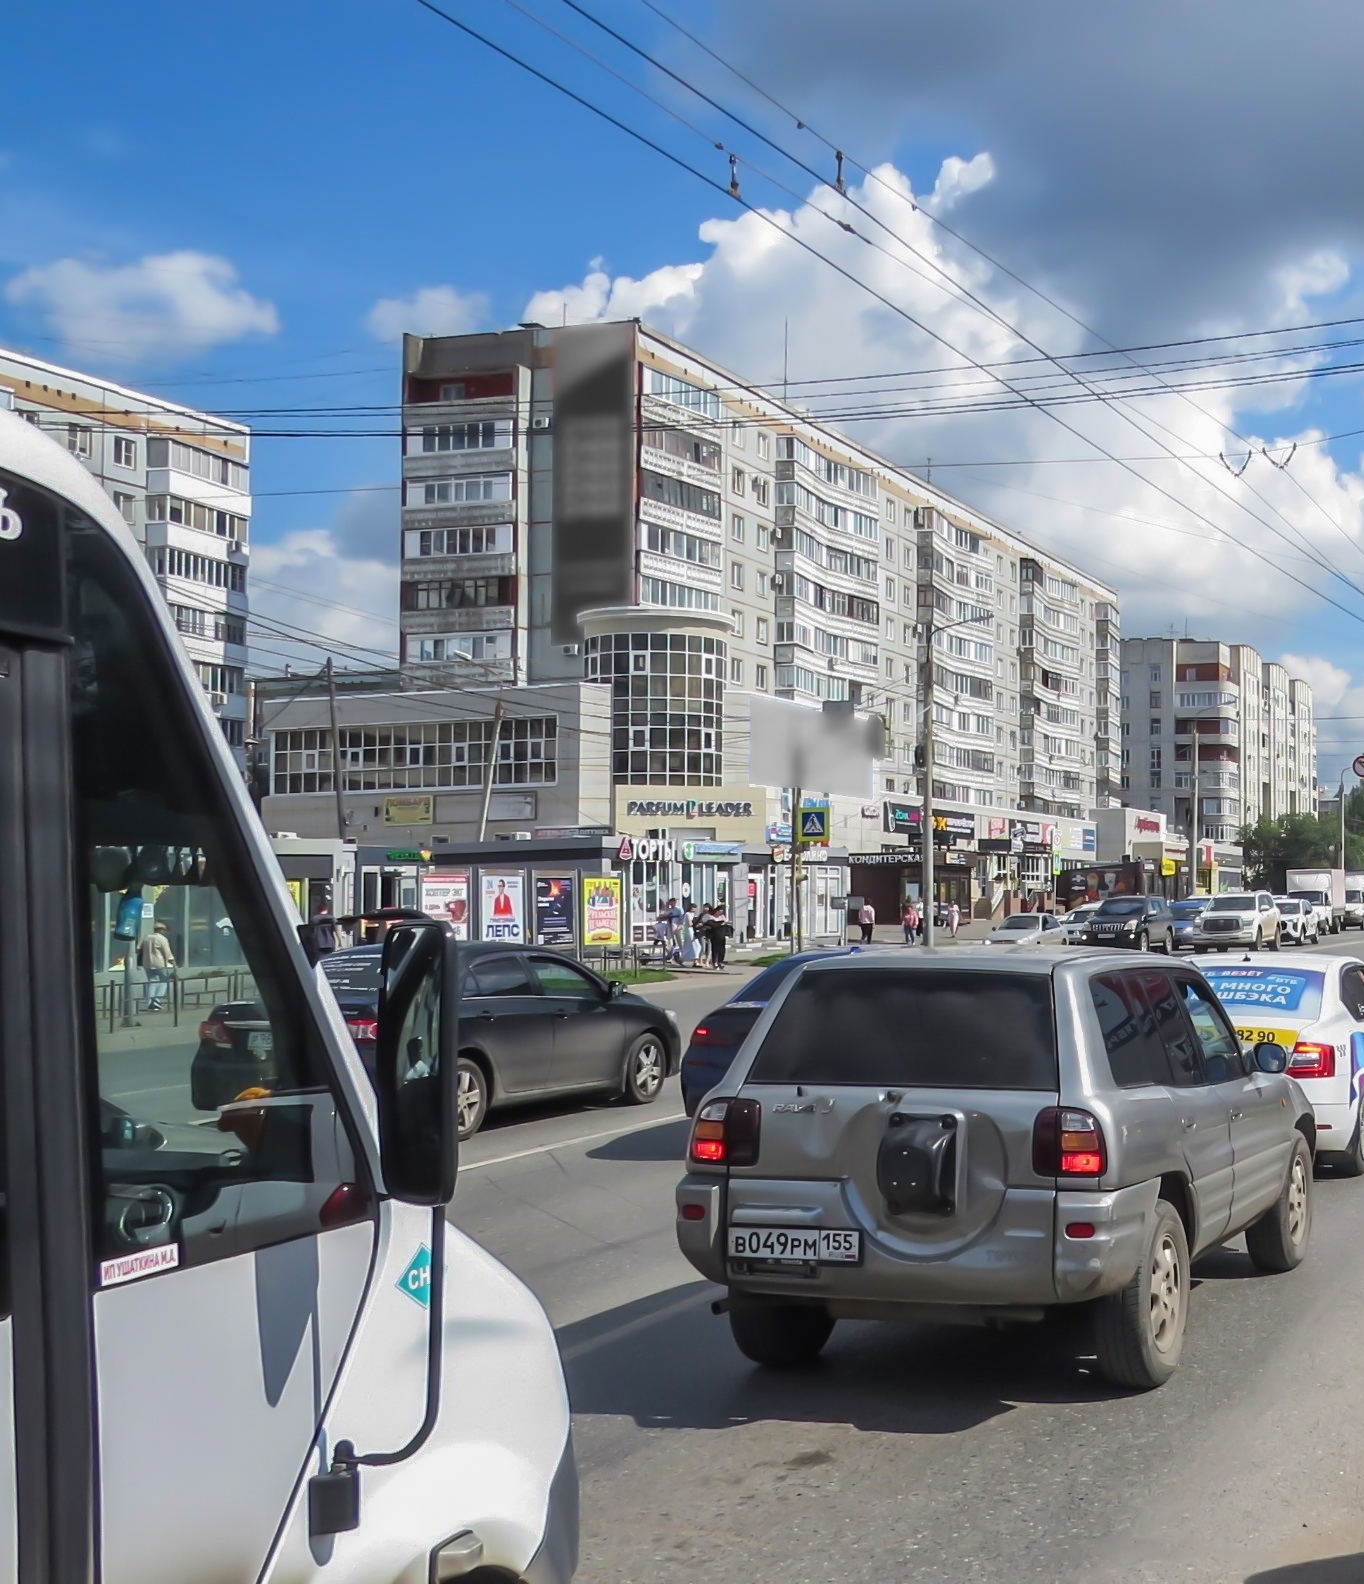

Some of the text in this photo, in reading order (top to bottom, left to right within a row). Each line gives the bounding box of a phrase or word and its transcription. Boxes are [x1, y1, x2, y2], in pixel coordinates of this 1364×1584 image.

[627, 801, 754, 817] PARFUM LEADER
[631, 838, 677, 861] ТОРТЫ
[486, 924, 520, 938] ЛЕПС
[1220, 982, 1291, 994] МНОГО
[1257, 1030, 1276, 1043] 90
[734, 1231, 853, 1257] В049РМ 155
